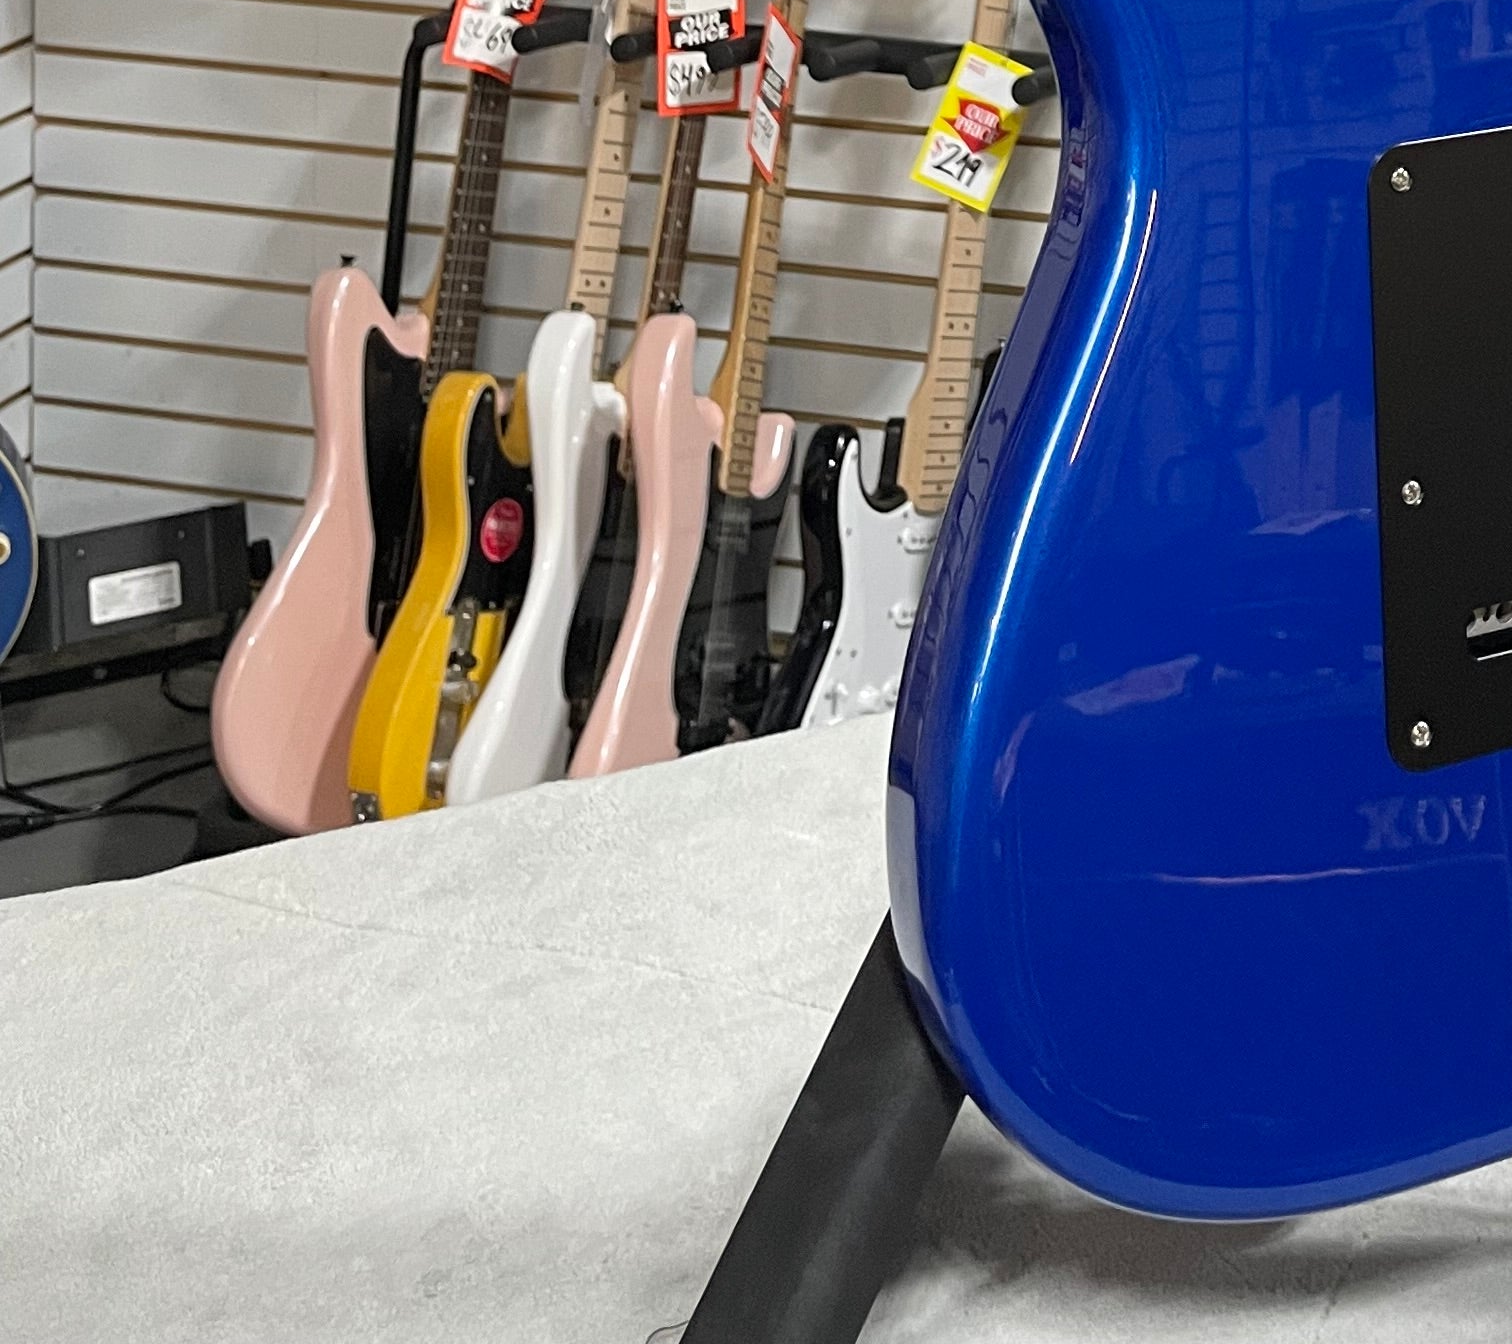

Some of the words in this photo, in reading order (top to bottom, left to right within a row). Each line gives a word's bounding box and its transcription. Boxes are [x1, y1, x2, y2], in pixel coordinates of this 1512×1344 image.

[680, 11, 721, 32] OUR
[674, 22, 730, 48] PRICE
[964, 103, 1000, 128] OUR
